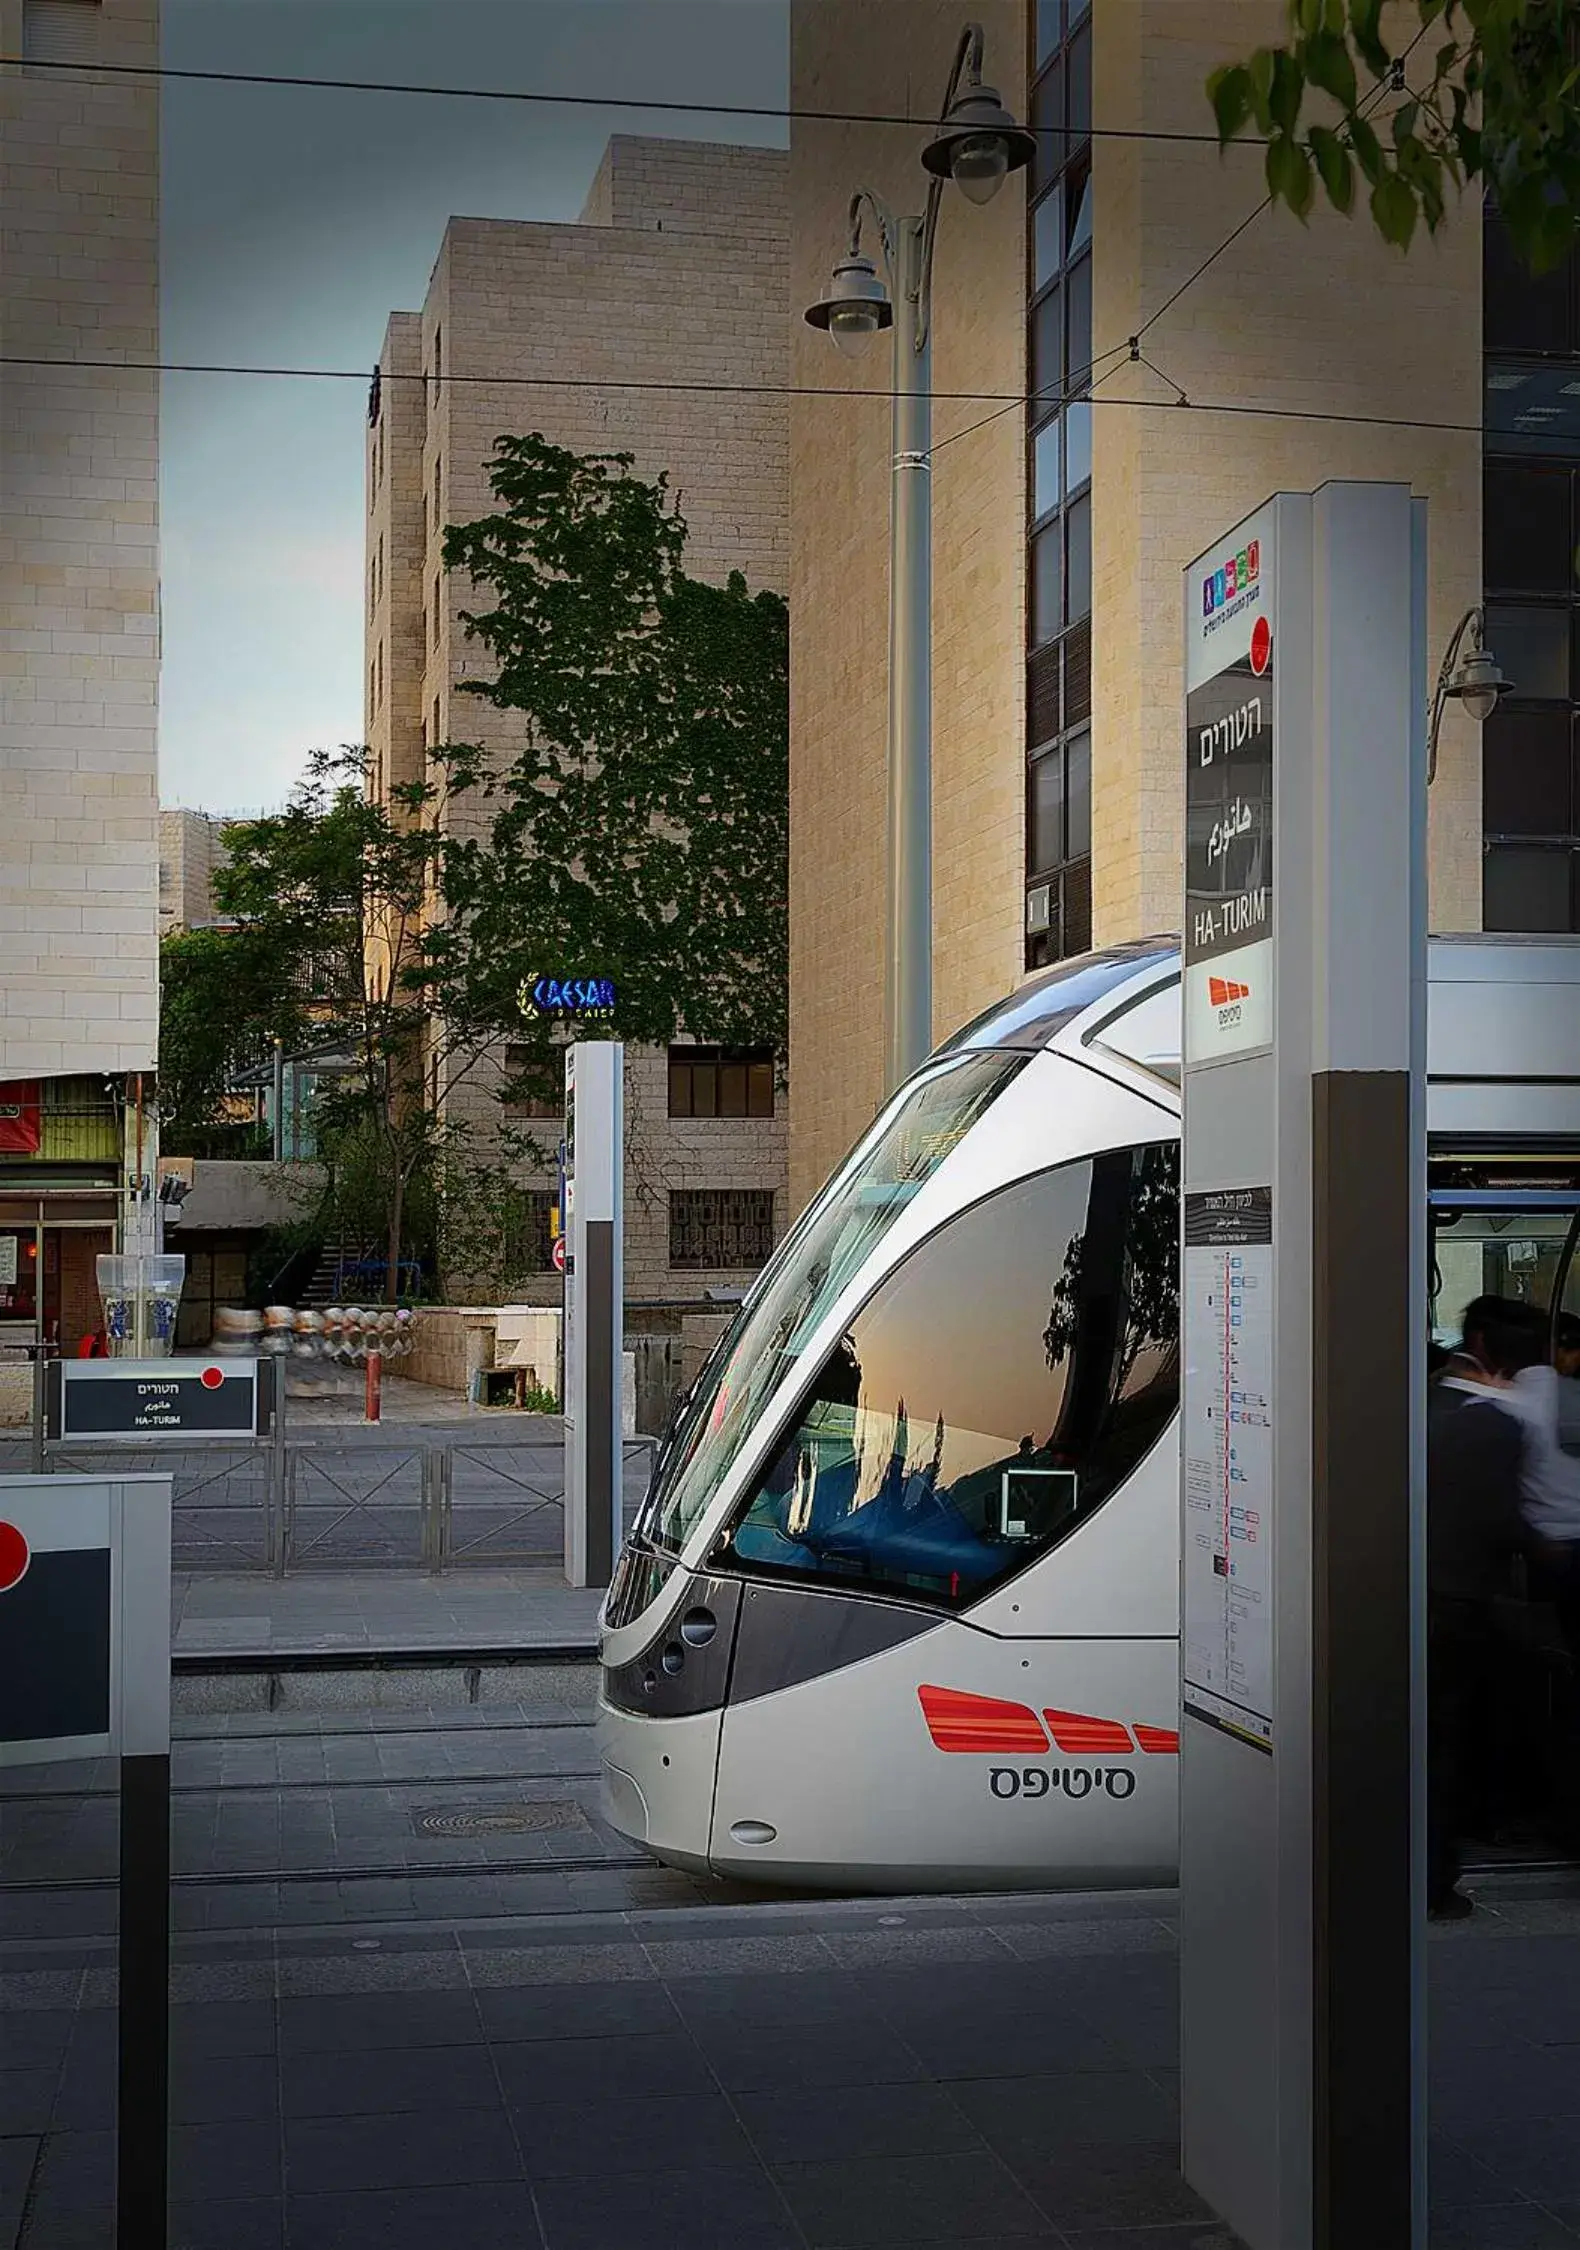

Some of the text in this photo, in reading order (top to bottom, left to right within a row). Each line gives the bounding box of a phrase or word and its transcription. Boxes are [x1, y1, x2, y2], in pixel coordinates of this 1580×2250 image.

[1200, 697, 1262, 768] הטורים
[1194, 886, 1266, 947] HA-TURIM
[135, 1416, 180, 1425] HA-TURIM
[989, 1767, 1136, 1799] סיטיפס
